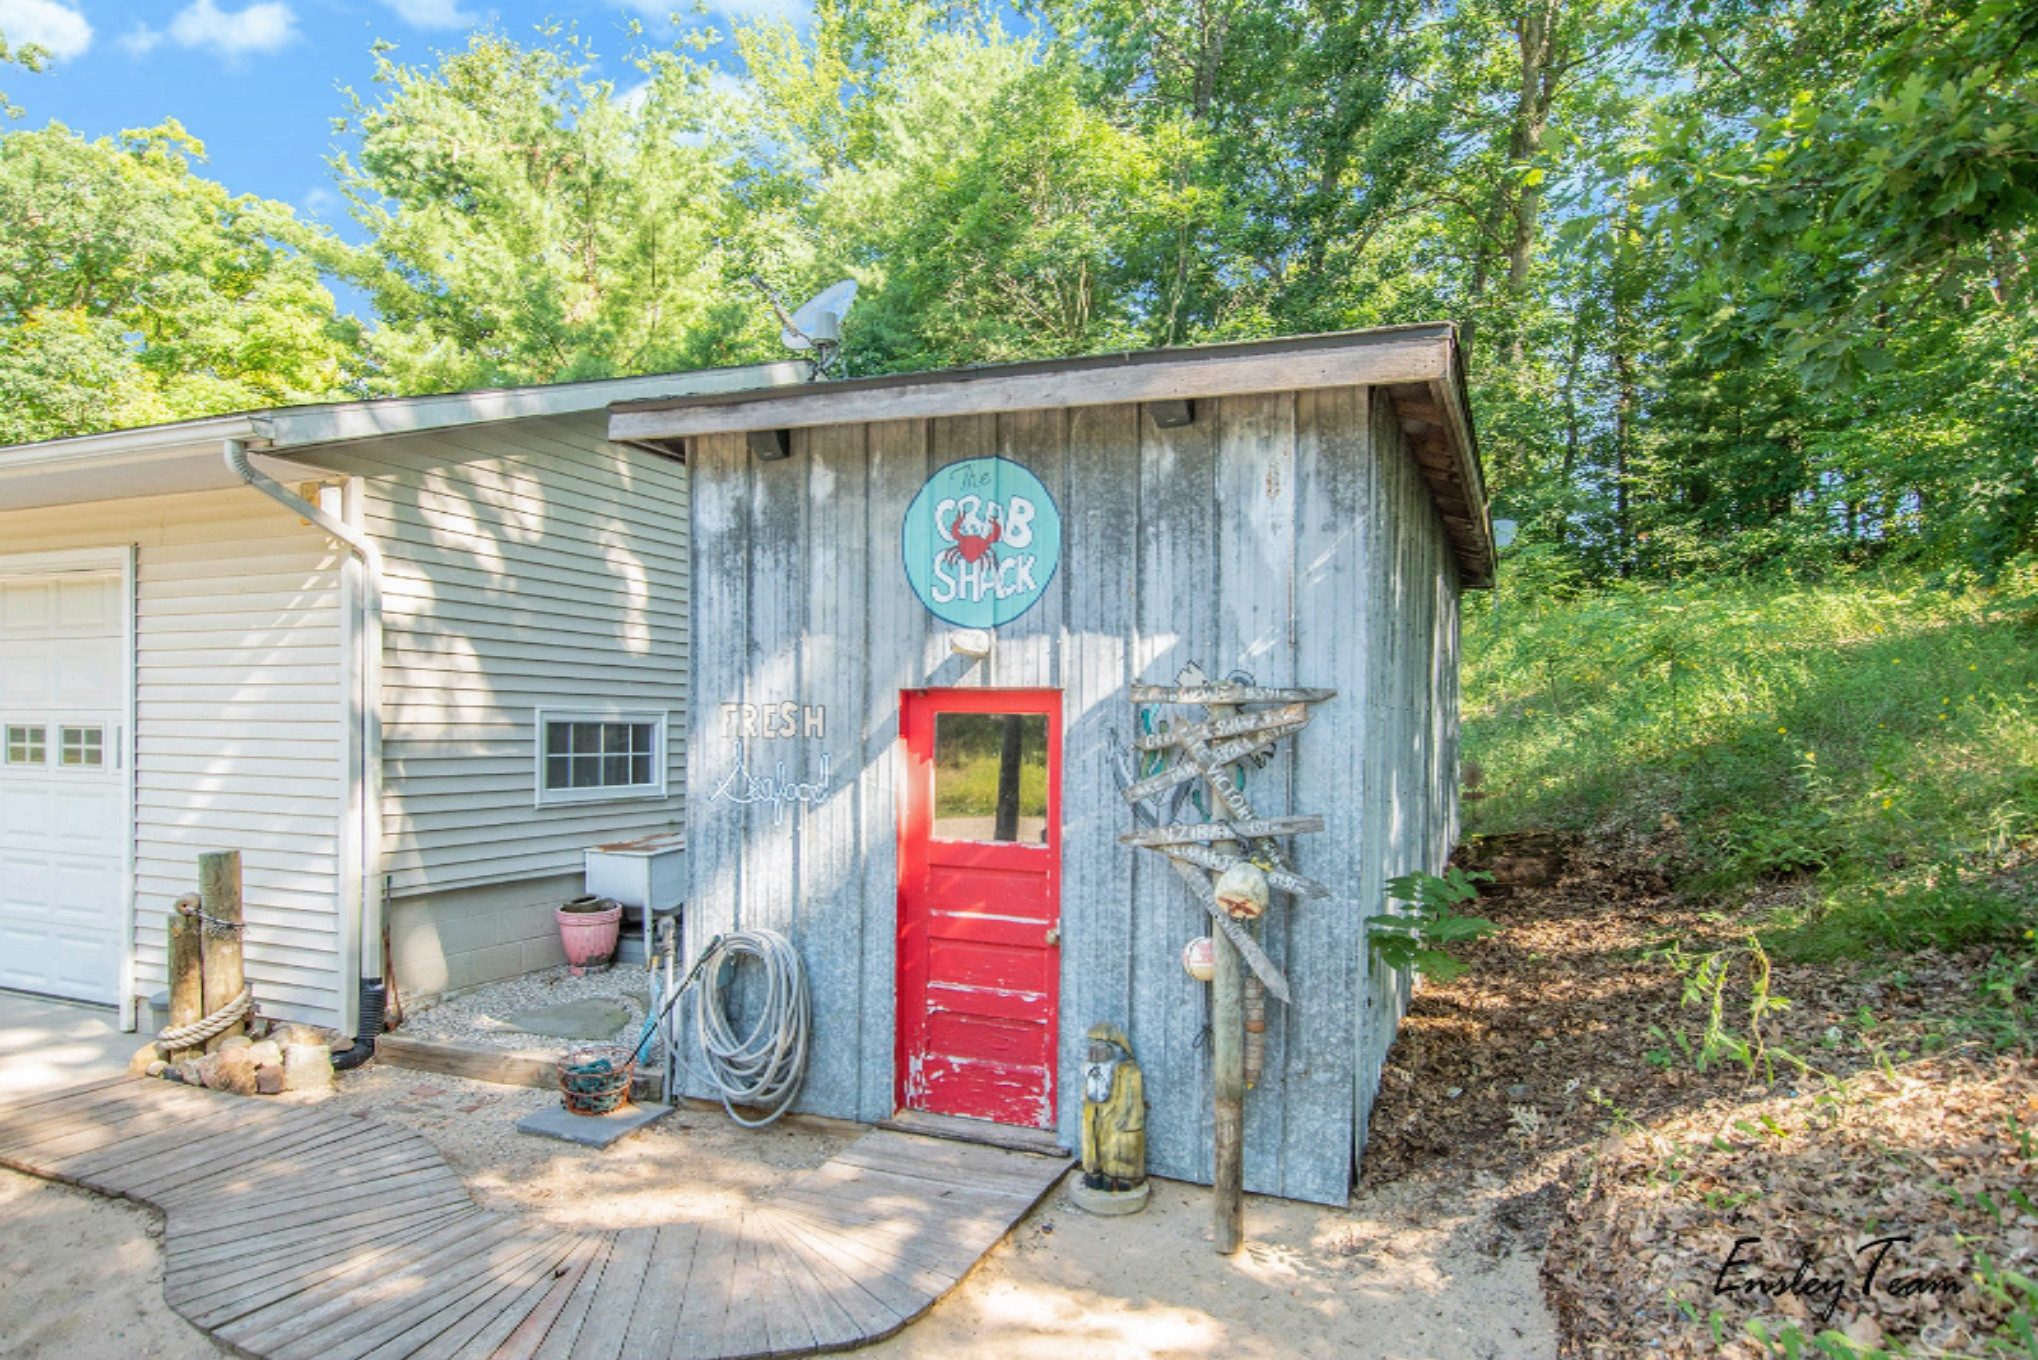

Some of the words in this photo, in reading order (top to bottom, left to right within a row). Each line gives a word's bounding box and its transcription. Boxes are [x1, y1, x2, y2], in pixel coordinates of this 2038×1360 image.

[950, 464, 991, 490] The
[934, 495, 1036, 548] CRAB
[931, 550, 1037, 603] SHACK
[719, 700, 826, 739] FRESH
